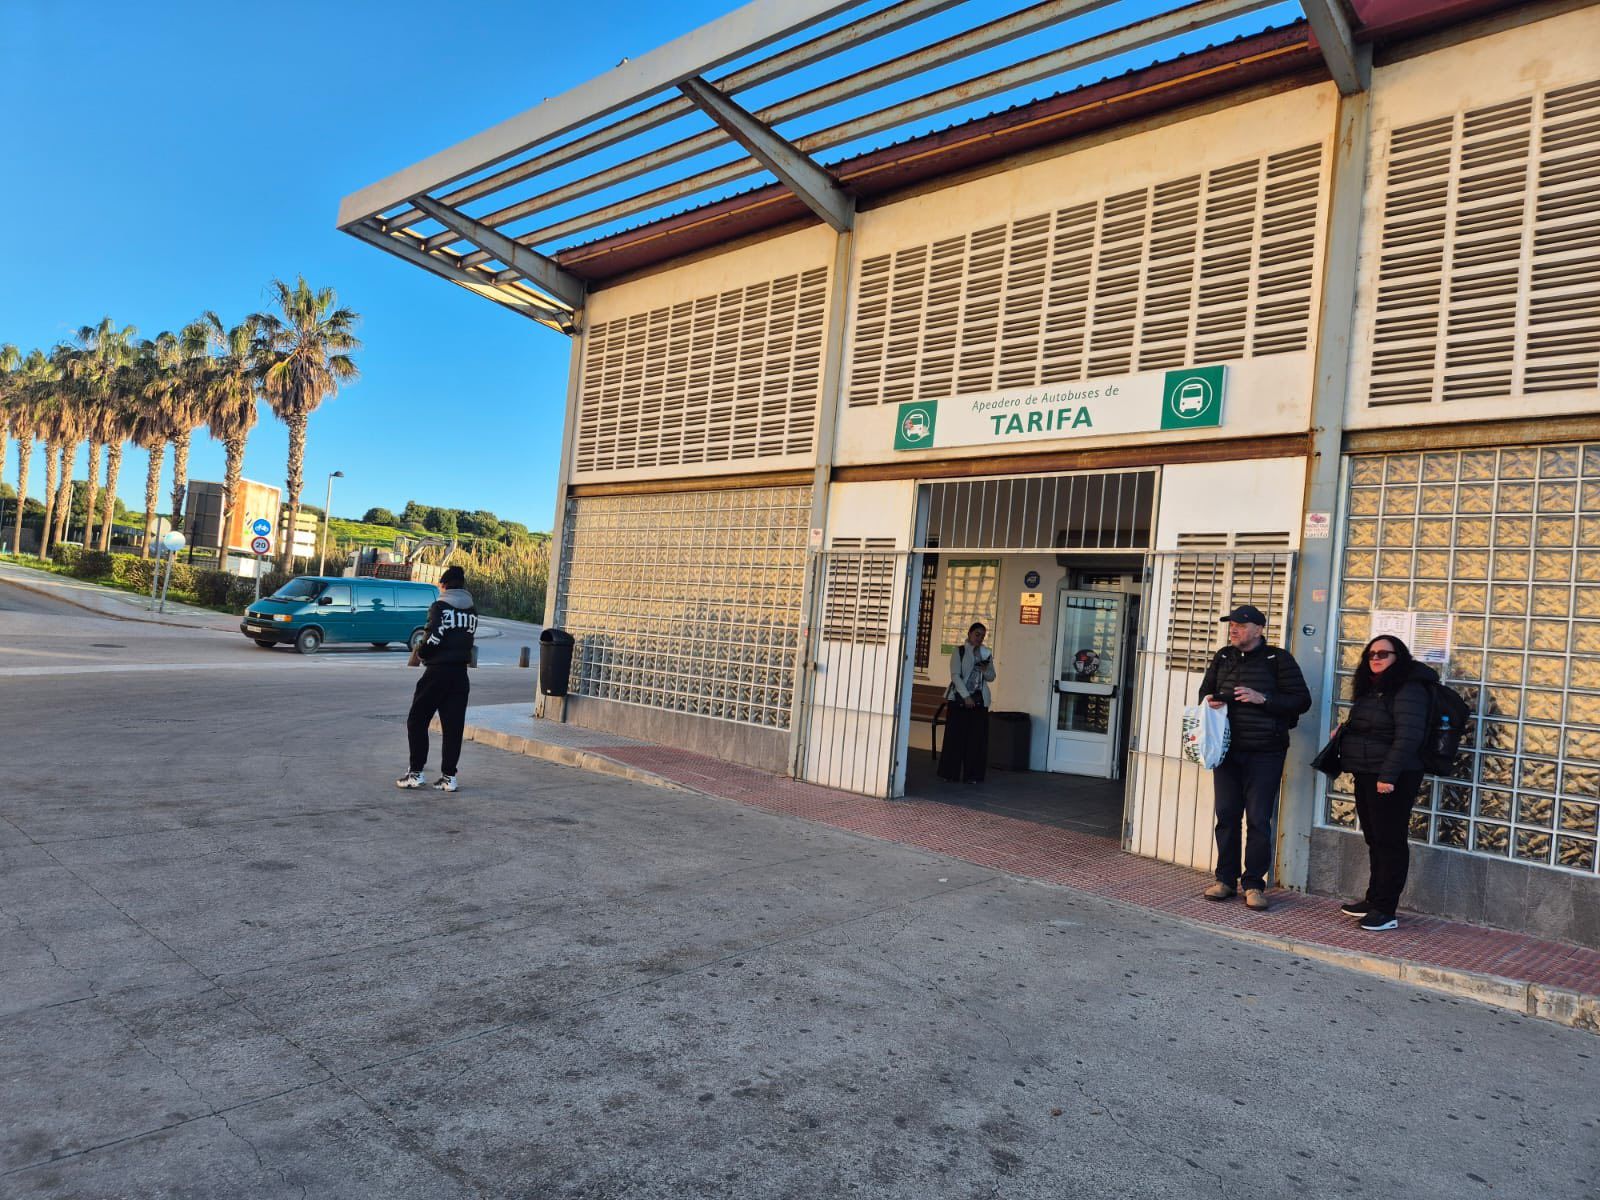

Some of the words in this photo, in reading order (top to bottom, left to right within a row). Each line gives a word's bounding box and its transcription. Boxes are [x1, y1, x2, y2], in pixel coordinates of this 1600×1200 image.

[972, 397, 1021, 413] Apeadero
[1025, 394, 1038, 405] de
[1041, 388, 1100, 403] Autobuses
[1105, 385, 1119, 397] de
[990, 406, 1094, 435] TARIFA
